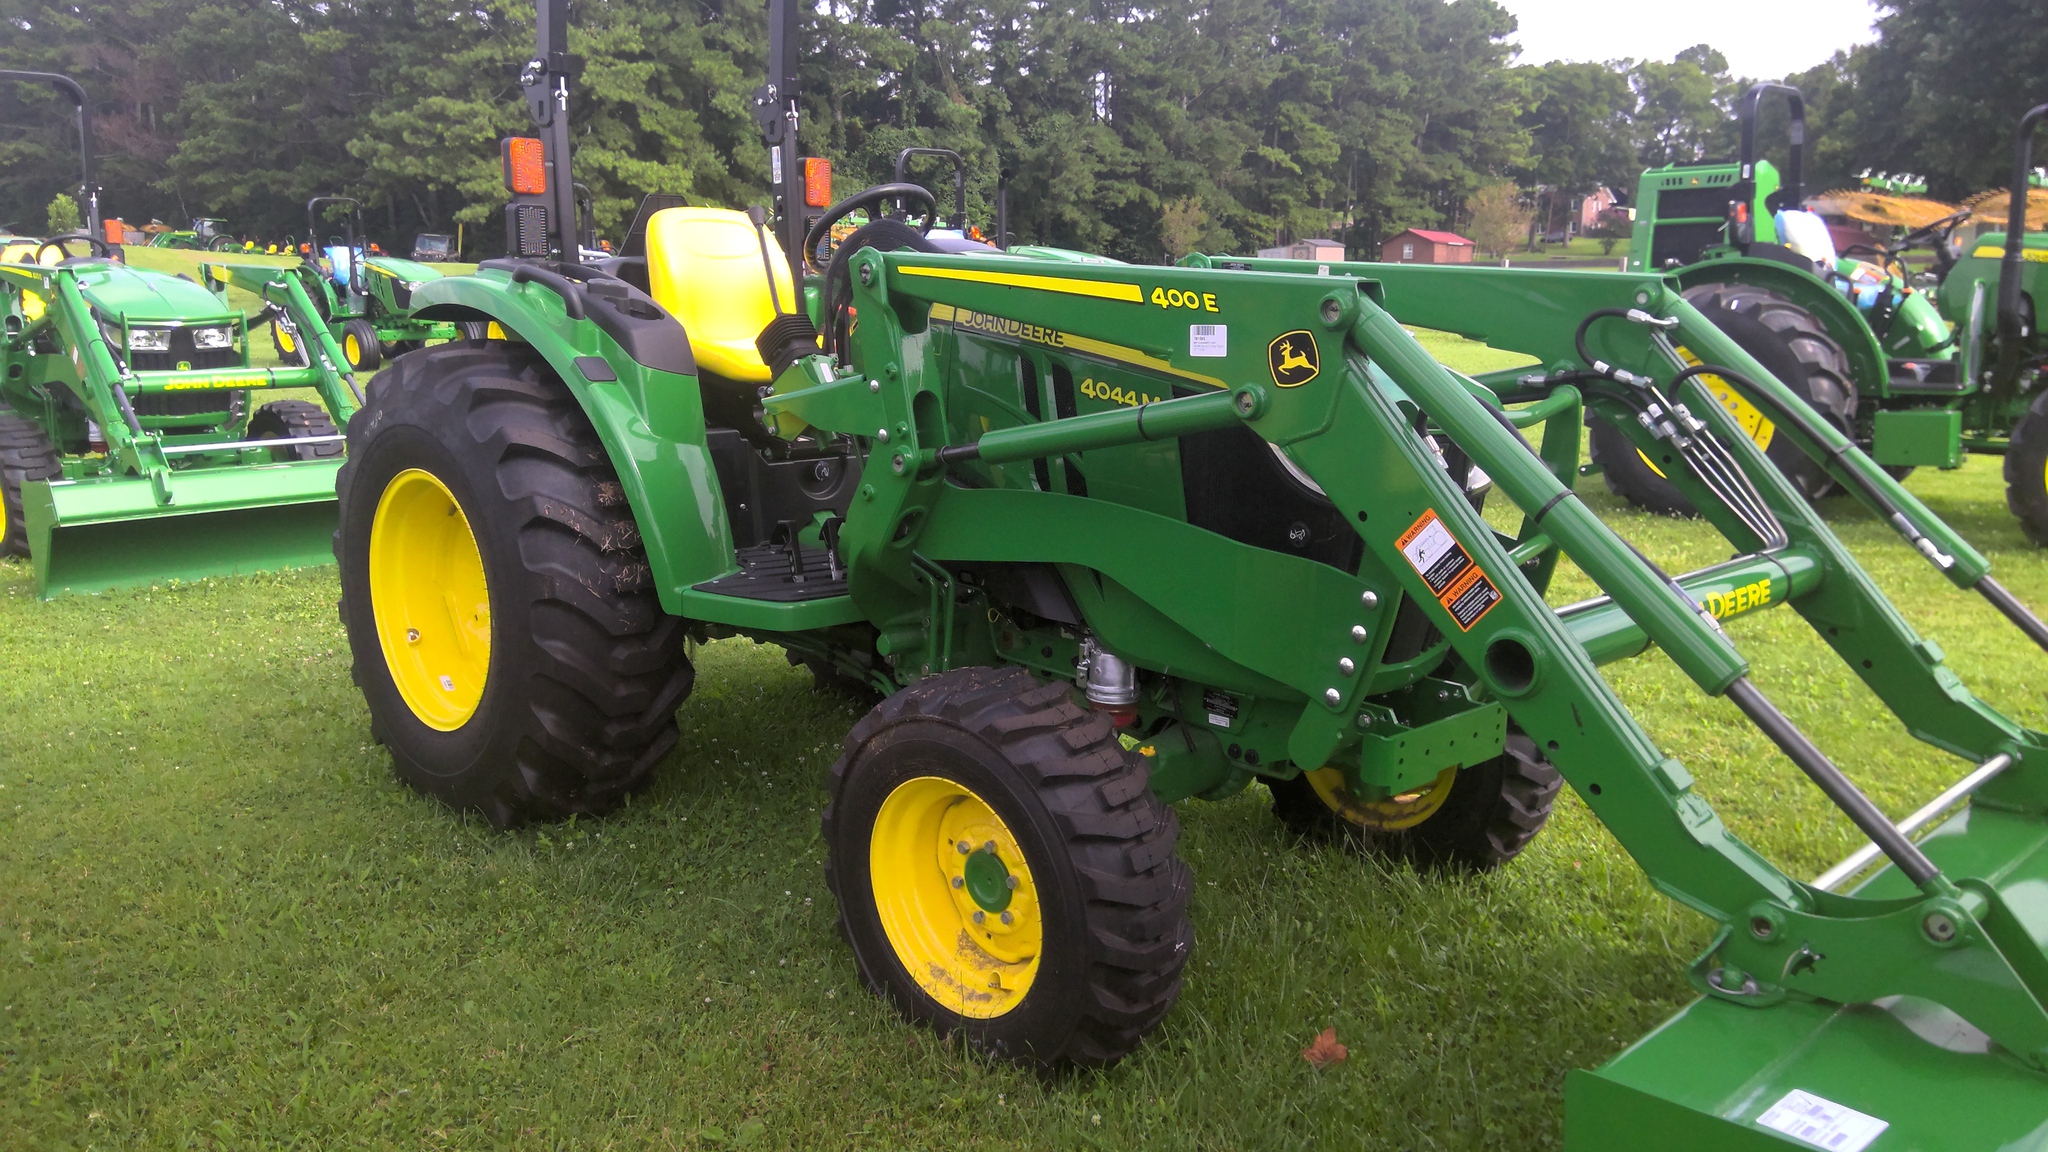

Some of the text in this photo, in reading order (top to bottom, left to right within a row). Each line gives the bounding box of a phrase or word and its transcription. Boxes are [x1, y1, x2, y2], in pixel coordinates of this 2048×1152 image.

[1150, 286, 1220, 313] 400 E
[964, 311, 1064, 347] JOHN DEERE
[164, 374, 268, 391] JOHN DEERE
[1080, 378, 1138, 407] 4044
[1406, 514, 1431, 540] WARNING
[1451, 571, 1479, 596] WARNING
[1706, 579, 1771, 619] DEERE
